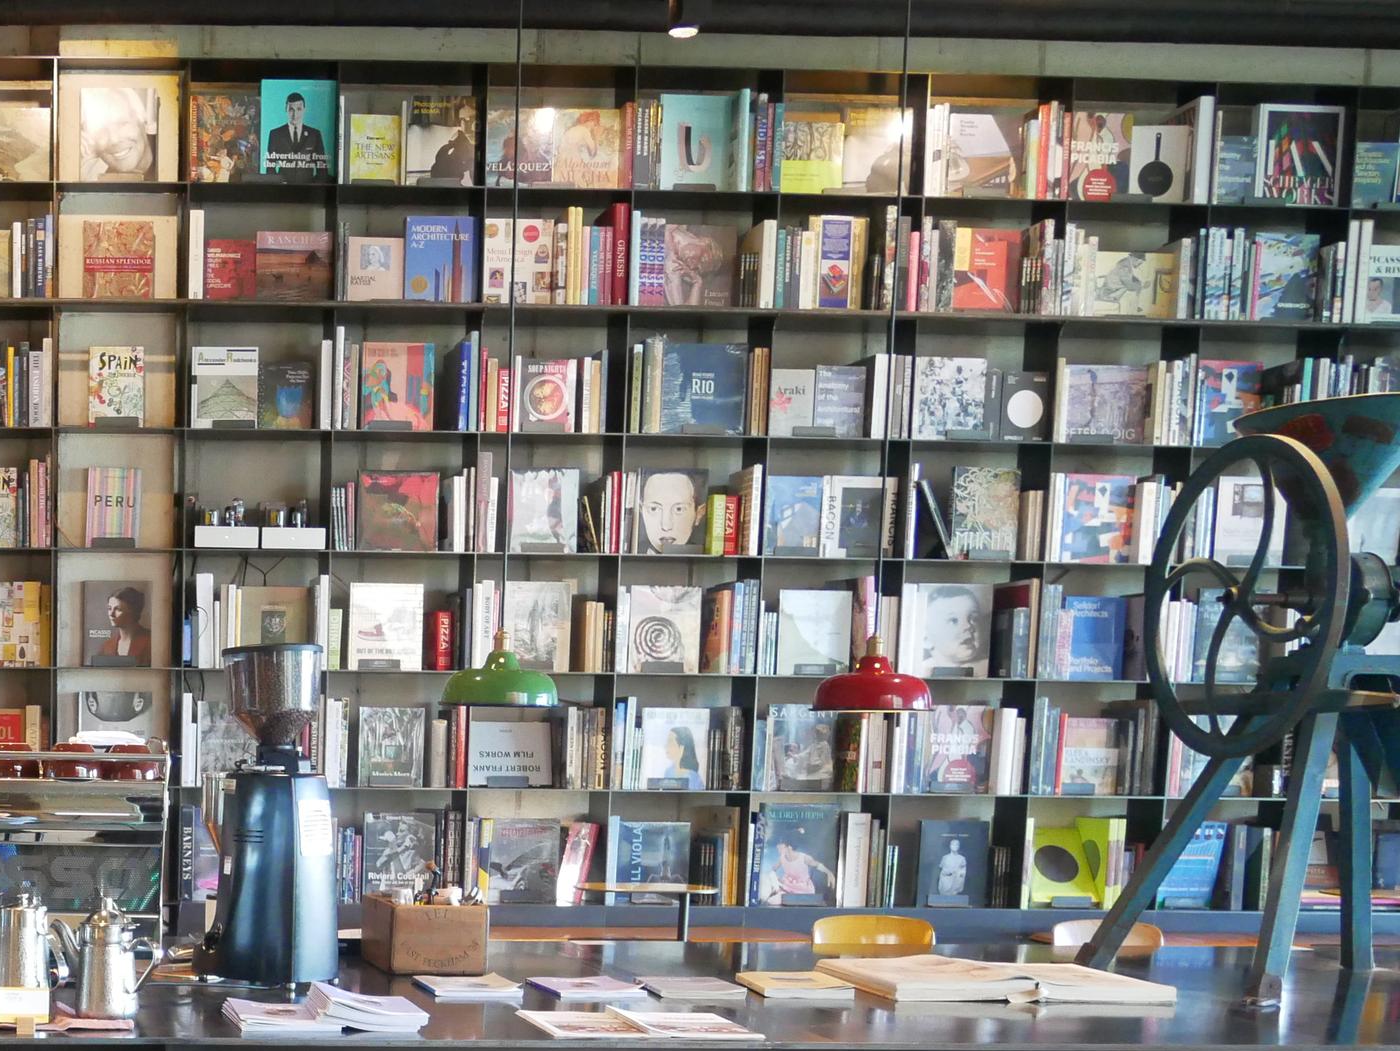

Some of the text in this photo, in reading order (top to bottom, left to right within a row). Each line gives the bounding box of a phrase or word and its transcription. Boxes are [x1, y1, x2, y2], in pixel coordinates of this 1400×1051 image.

[354, 143, 396, 152] THE NEW
[1070, 141, 1119, 152] FRANCIS
[263, 152, 310, 162] Advertising
[263, 160, 276, 168] the
[277, 160, 297, 168] Mad
[298, 160, 315, 168] Men
[485, 161, 551, 172] VELÁQUEZ
[410, 224, 447, 233] MODERN
[410, 232, 470, 242] ARCHITECTURE
[86, 258, 152, 266] RUSSIAN SPLENDOR
[617, 239, 626, 278] GENESIS
[1369, 256, 1400, 264] ICASS
[692, 378, 714, 394] RIO
[776, 385, 806, 396] Araki
[500, 376, 509, 409] PIZZA
[94, 495, 137, 508] PERU
[726, 503, 734, 537] PIZZA
[828, 496, 838, 540] BACON
[330, 615, 339, 648] DRINK
[440, 617, 449, 650] PIZZA
[930, 733, 978, 744] FRANCIS
[480, 750, 534, 758] FILM WORKS
[1282, 727, 1294, 776] ARNEYS
[473, 764, 541, 773] ROBERT FRANK
[183, 826, 192, 880] BARNEYS
[368, 872, 430, 880] Riviera Cocktail
